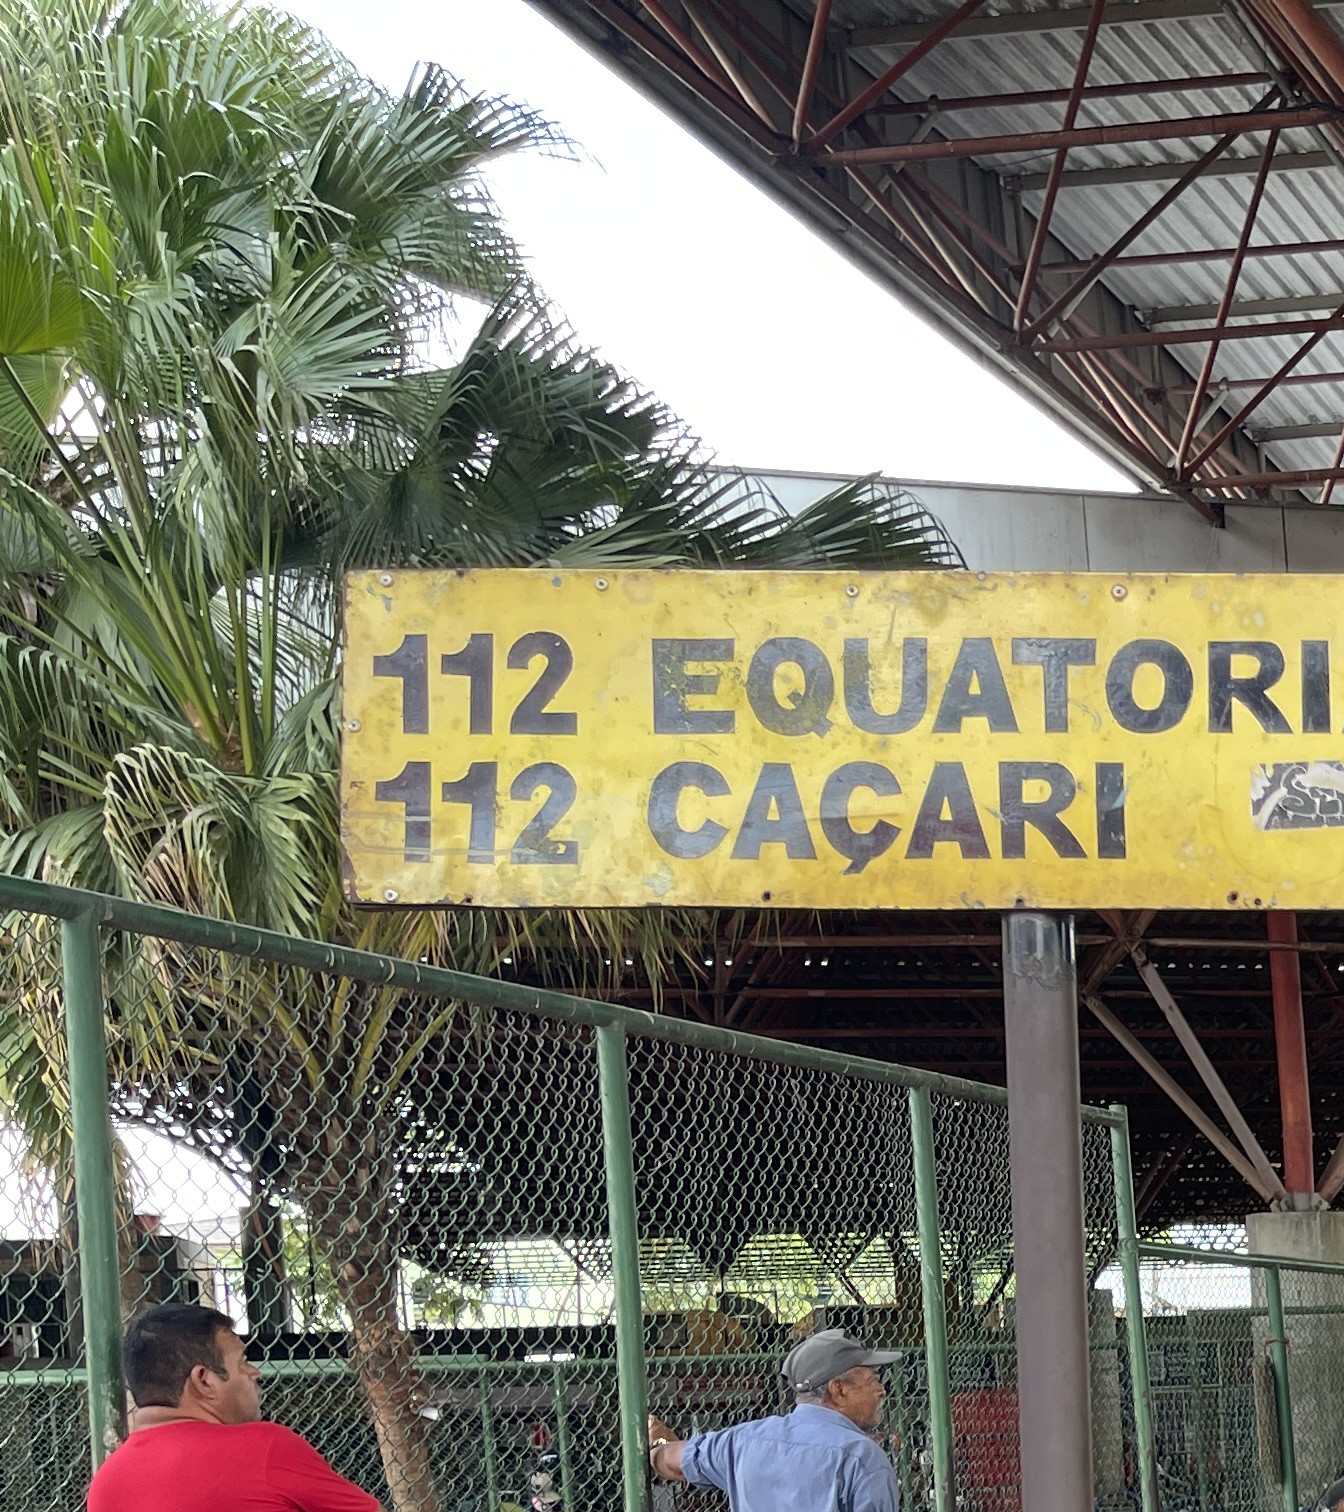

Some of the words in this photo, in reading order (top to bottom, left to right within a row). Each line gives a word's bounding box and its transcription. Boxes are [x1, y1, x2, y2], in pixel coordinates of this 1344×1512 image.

[372, 631, 578, 736] 112
[374, 760, 580, 864] 112
[646, 760, 1127, 877] CAÇARI
